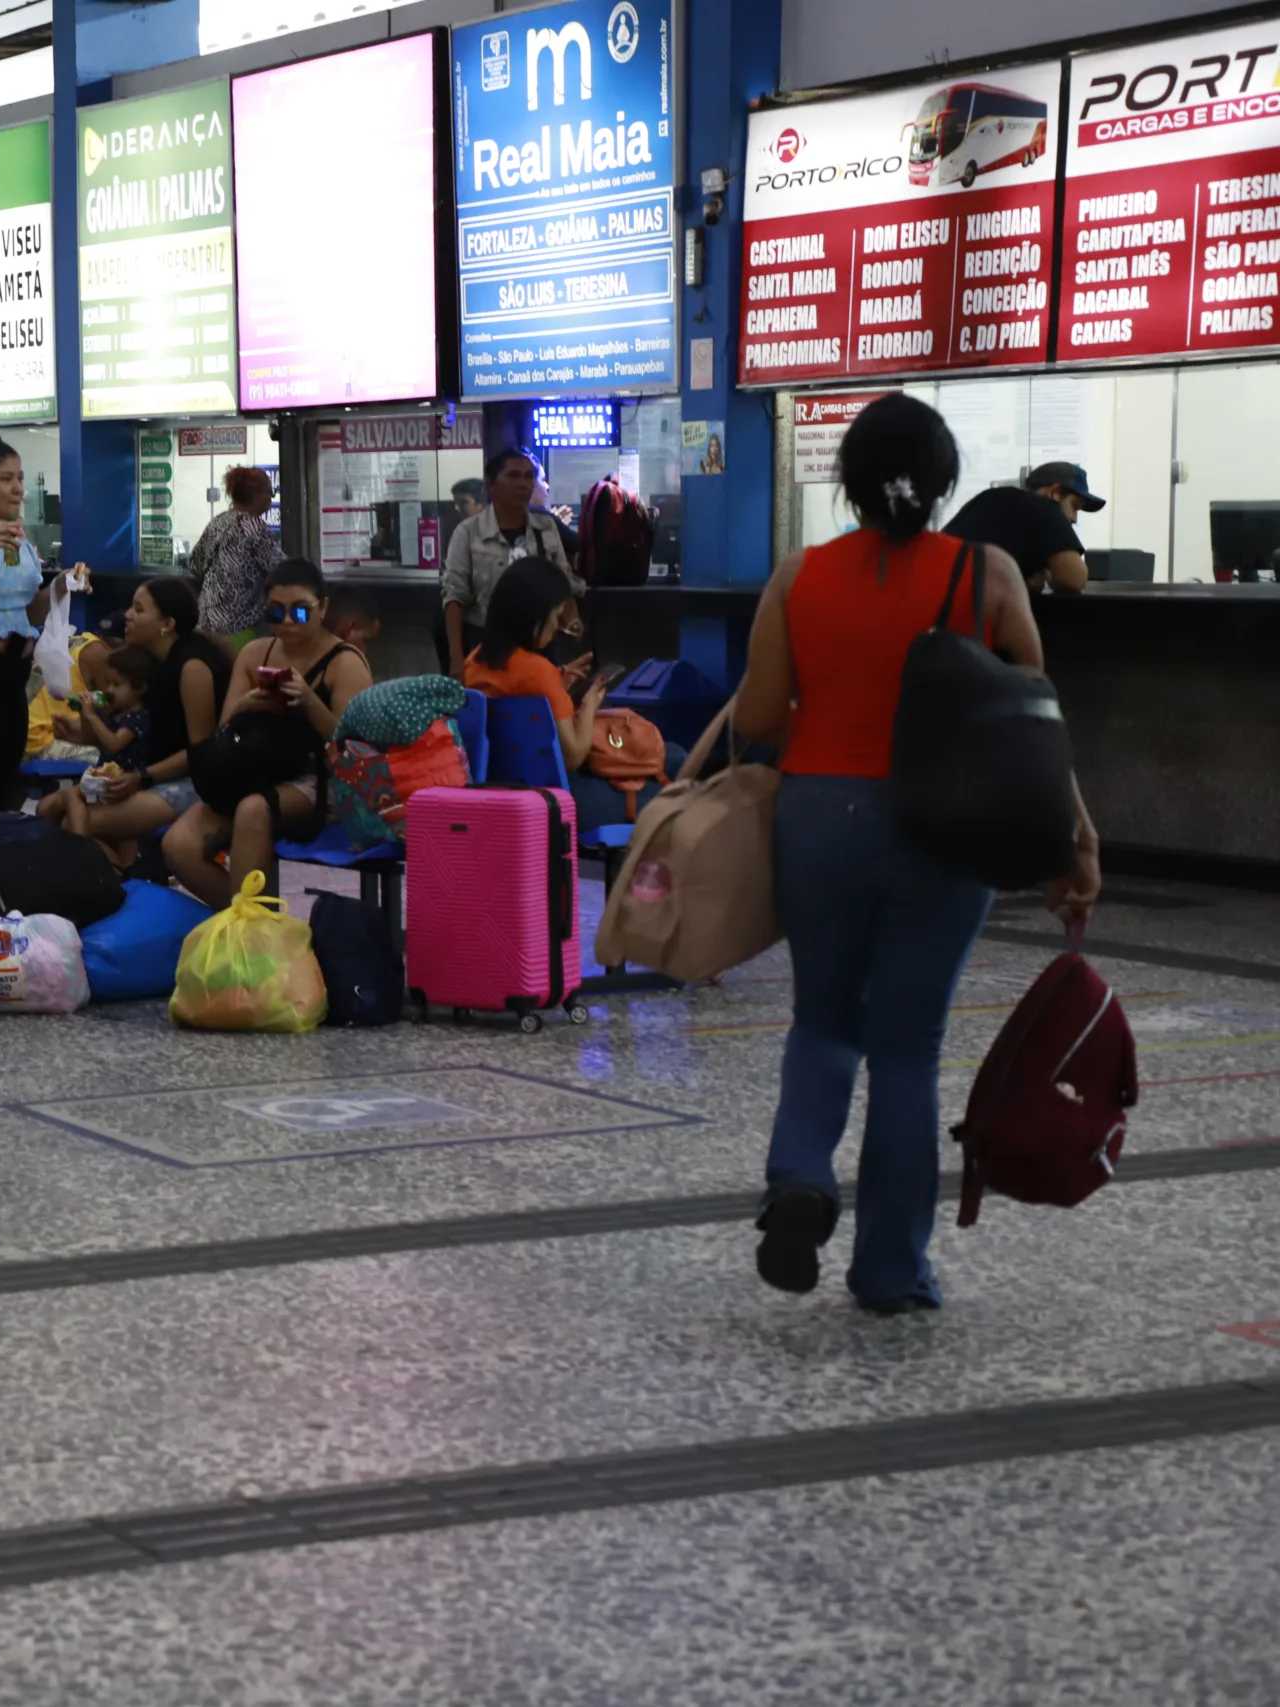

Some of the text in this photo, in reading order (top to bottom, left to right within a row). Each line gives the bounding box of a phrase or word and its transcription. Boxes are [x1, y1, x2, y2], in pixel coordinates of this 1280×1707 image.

[1095, 94, 1280, 141] CARGAS E ENCO
[473, 111, 652, 191] Real Maia
[592, 179, 611, 191] todos
[622, 171, 656, 185] caminhos
[755, 165, 837, 193] PORTO
[1208, 173, 1280, 206] TERESIN
[86, 165, 225, 234] GOIÂNIA PALMAS
[1079, 190, 1158, 223] PINHEIRO
[467, 206, 663, 257] FORTALEZA GOIÂNIA PALMAS
[863, 217, 950, 254] DOM ELISEU
[966, 205, 1041, 241] XINGUARA
[1077, 218, 1186, 253] CARUTAPERA
[1206, 206, 1280, 238] IMPERAT
[1, 223, 42, 258] VISEU
[749, 233, 825, 267] CASTANHAL
[1204, 239, 1280, 271] SÃO PAU
[156, 241, 226, 282] MPERATRIZ
[862, 257, 923, 290] RONDON
[964, 240, 1041, 279] REDENÇÃO
[1075, 249, 1170, 285] SANTA INÊS
[499, 272, 629, 310] SÃO LUIS TERESINA
[748, 267, 836, 301] SANTA MARIA
[962, 278, 1047, 316] CONCEIÇÃO
[1073, 285, 1149, 315] BACABAL
[1202, 271, 1278, 304] GOIÂNIA
[746, 304, 818, 335] CAPANEMA
[860, 289, 922, 325] MARABÁ
[1200, 305, 1273, 335] PALMAS
[1, 316, 43, 350] ELISEU
[857, 329, 934, 361] ELDORADO
[959, 315, 1041, 353] C. DO PIRIÁ
[1071, 318, 1133, 346] CAXIAS
[513, 348, 534, 363] Paulo
[556, 343, 587, 360] Eduardo
[588, 340, 629, 359] Magalhães
[635, 336, 670, 353] Barreiras
[745, 337, 841, 369] PARAGOMINAS
[474, 373, 503, 387] Altamira
[532, 368, 546, 383] dos
[580, 363, 608, 379] Marabá
[614, 360, 665, 377] Parauapebas
[847, 402, 869, 412] ENCO
[345, 416, 482, 449] SALVADOR SINA
[539, 415, 606, 435] REAL MAIA
